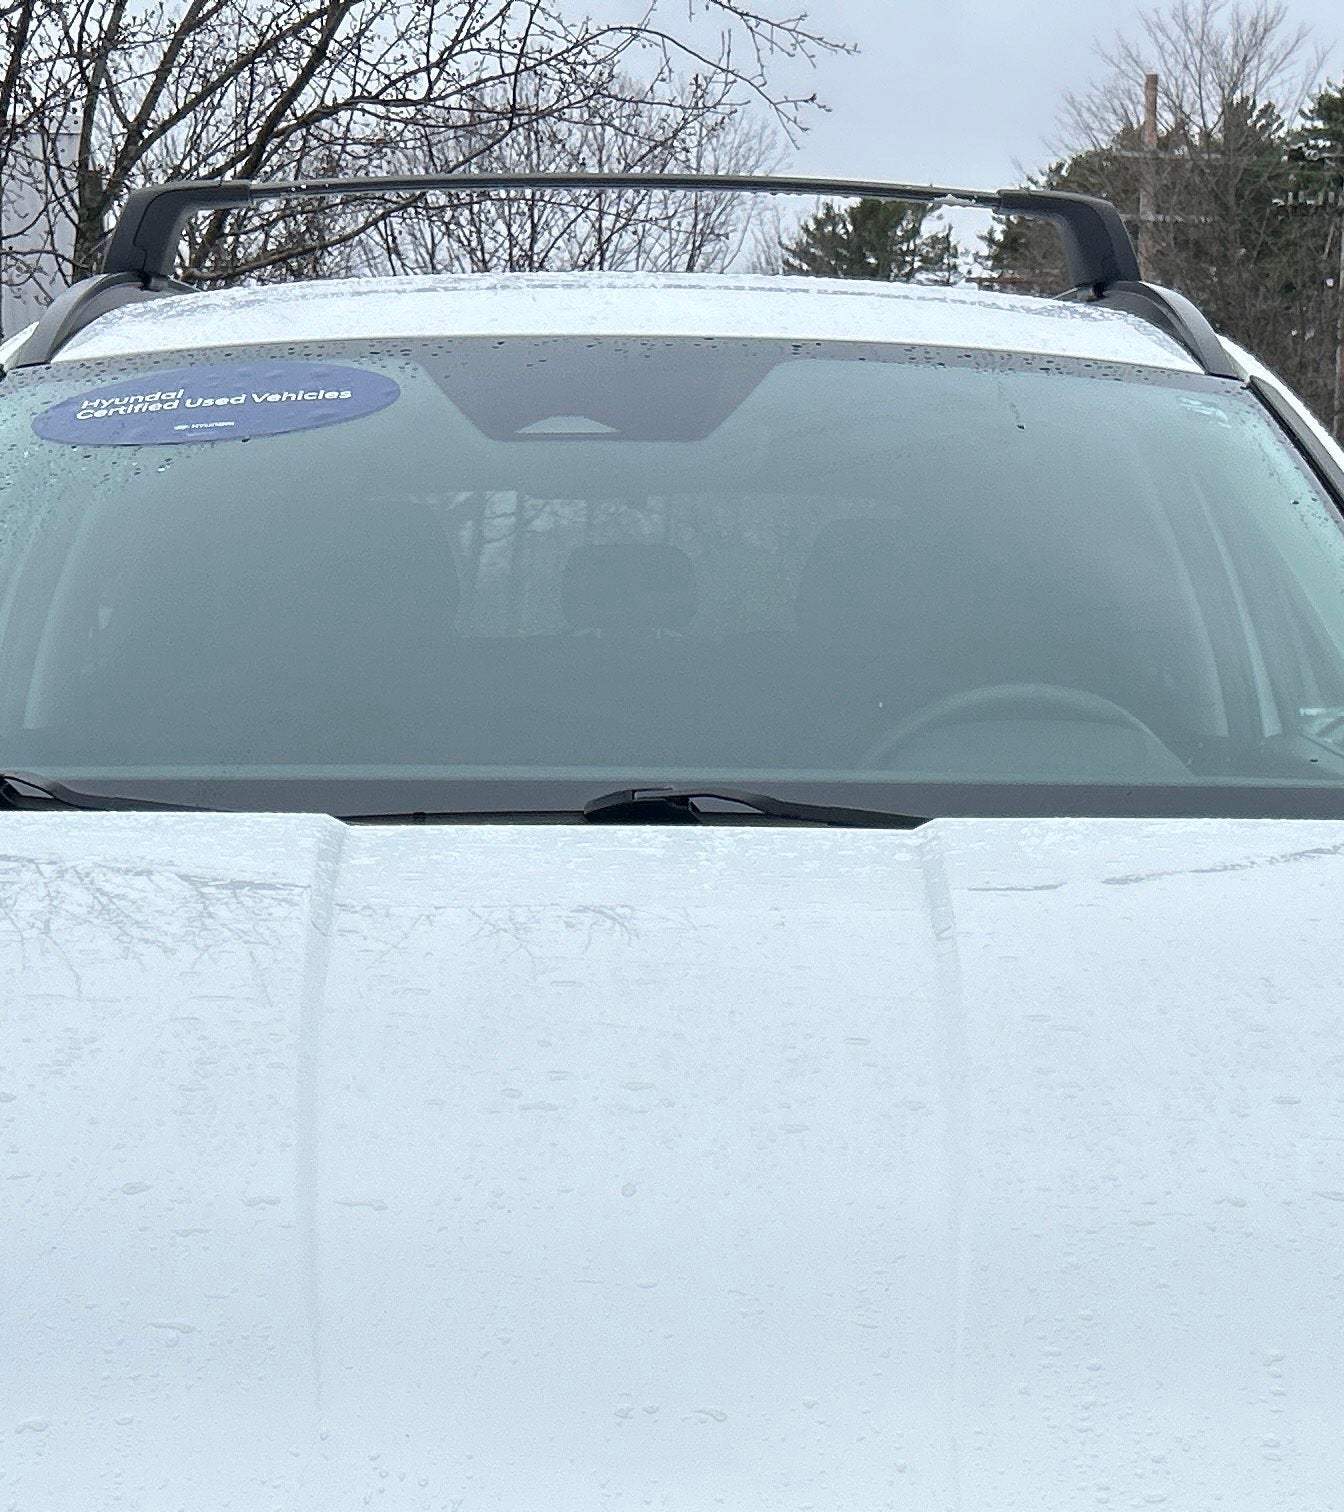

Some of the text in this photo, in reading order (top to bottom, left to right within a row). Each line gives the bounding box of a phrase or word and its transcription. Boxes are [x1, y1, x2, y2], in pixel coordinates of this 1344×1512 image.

[76, 389, 352, 420] Certified Used Vehicles
[81, 389, 185, 409] Hyundai
